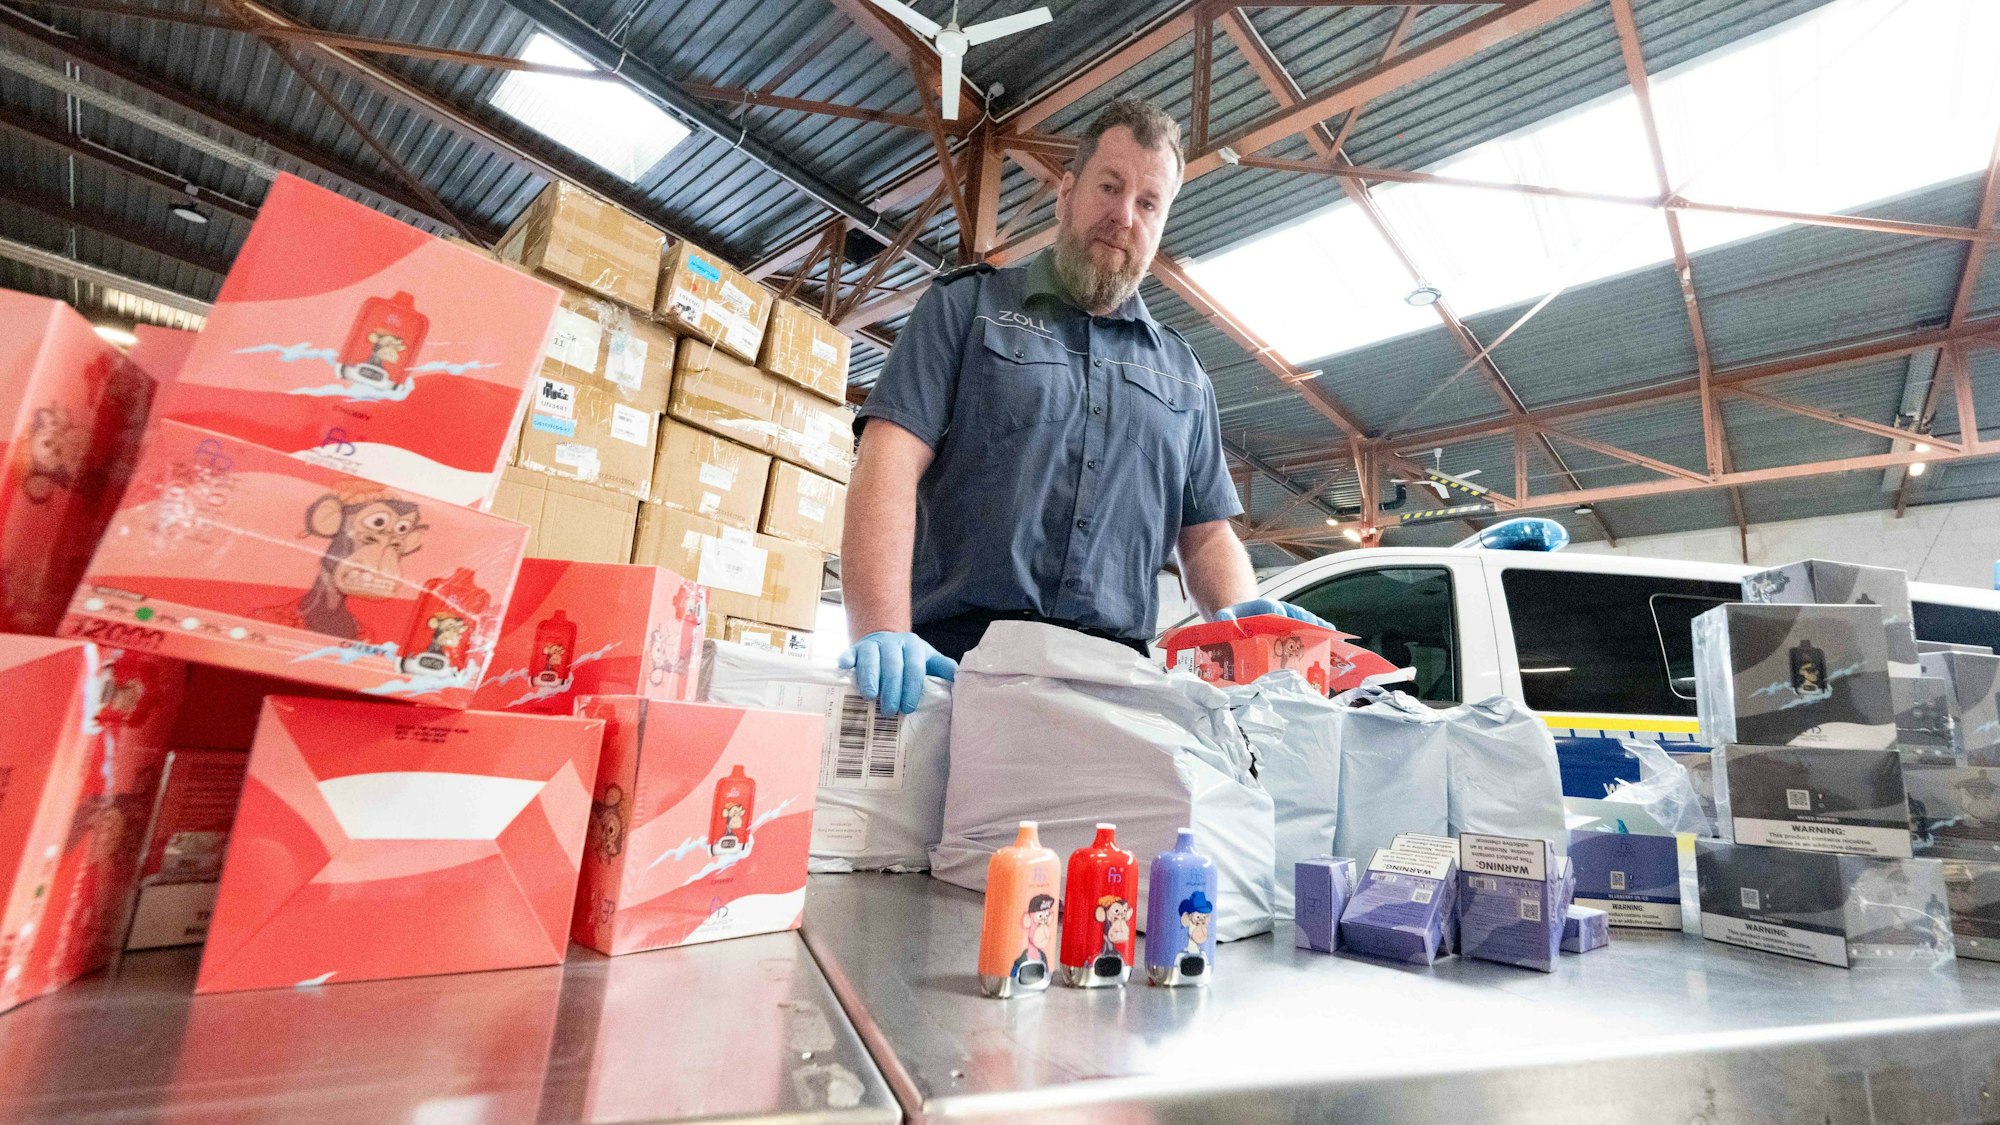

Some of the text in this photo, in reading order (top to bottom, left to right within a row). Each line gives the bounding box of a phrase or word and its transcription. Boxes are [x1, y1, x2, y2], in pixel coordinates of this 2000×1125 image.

[998, 310, 1053, 334] ZOLL
[1791, 823, 1846, 836] WARNING:
[1496, 853, 1518, 861] product
[1474, 860, 1529, 874] WARNING:
[1611, 903, 1644, 911] WARNING:
[1744, 922, 1790, 937] WARNING:
